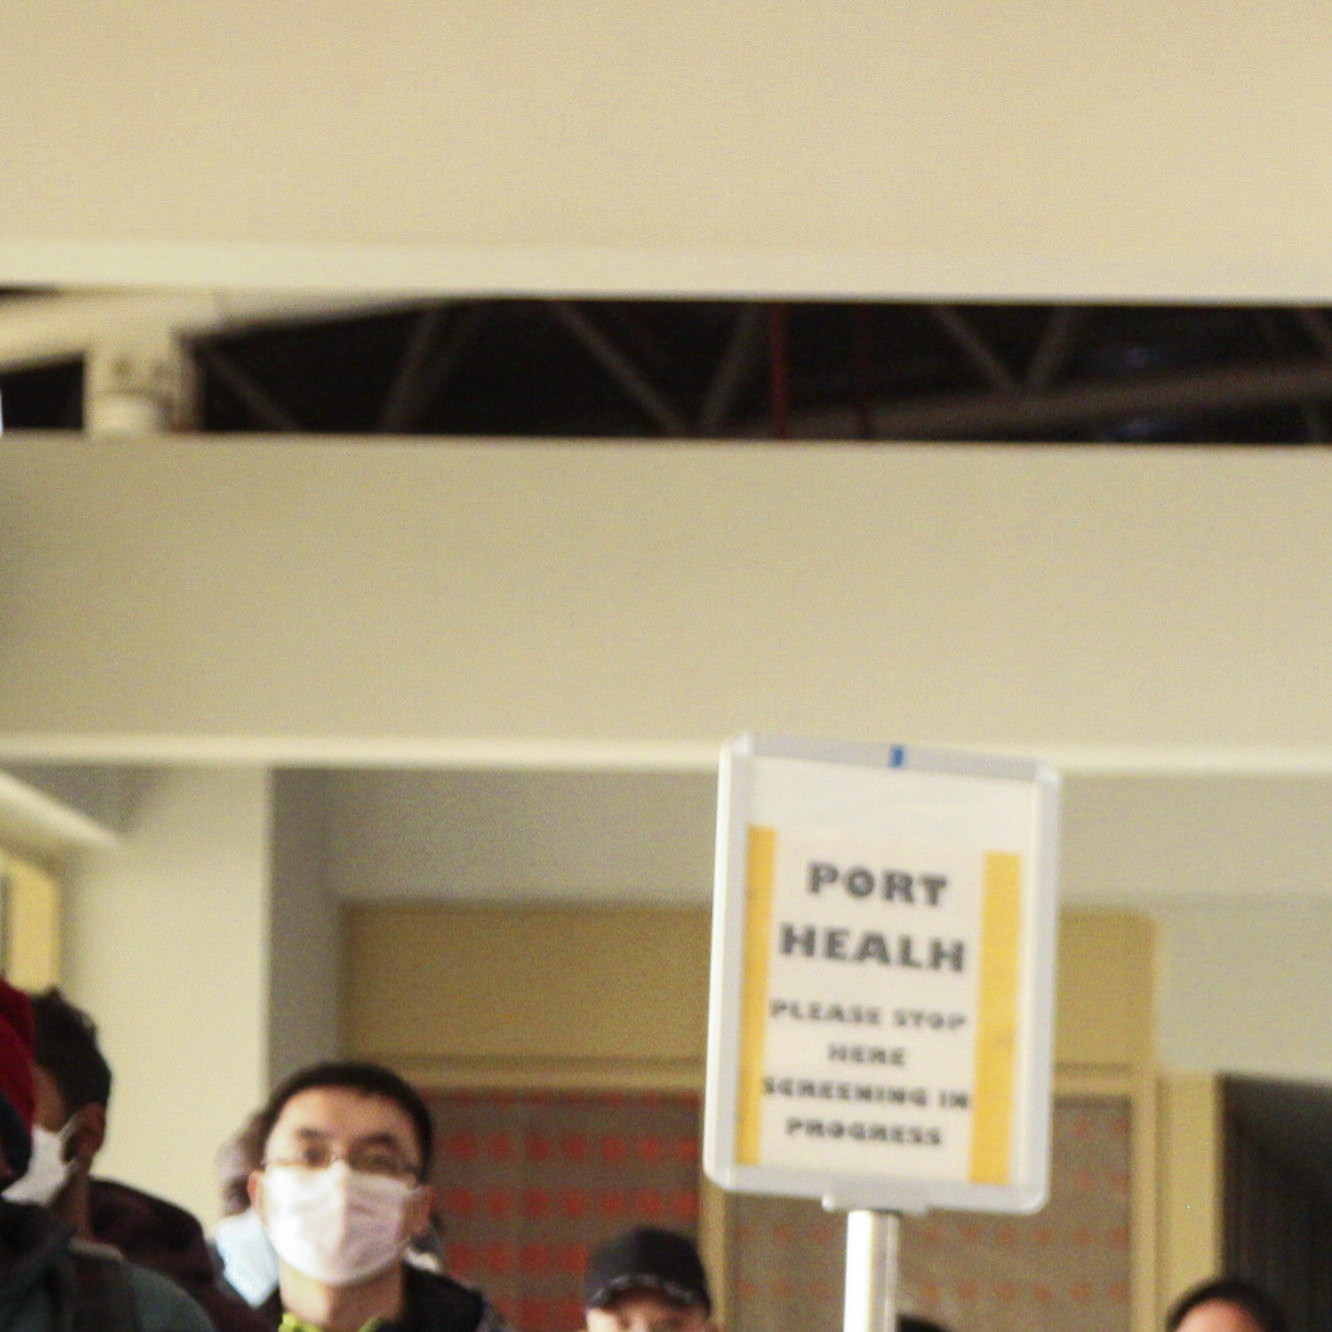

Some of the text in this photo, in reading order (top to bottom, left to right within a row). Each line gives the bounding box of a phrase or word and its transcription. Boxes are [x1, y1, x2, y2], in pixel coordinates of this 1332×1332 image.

[809, 862, 947, 905] PORT
[780, 924, 965, 972] HEALH
[770, 999, 965, 1029] PLEASE STOP
[828, 1045, 905, 1065] HERE
[763, 1076, 968, 1108] SCREENING IN
[788, 1117, 941, 1146] PROGRESS
